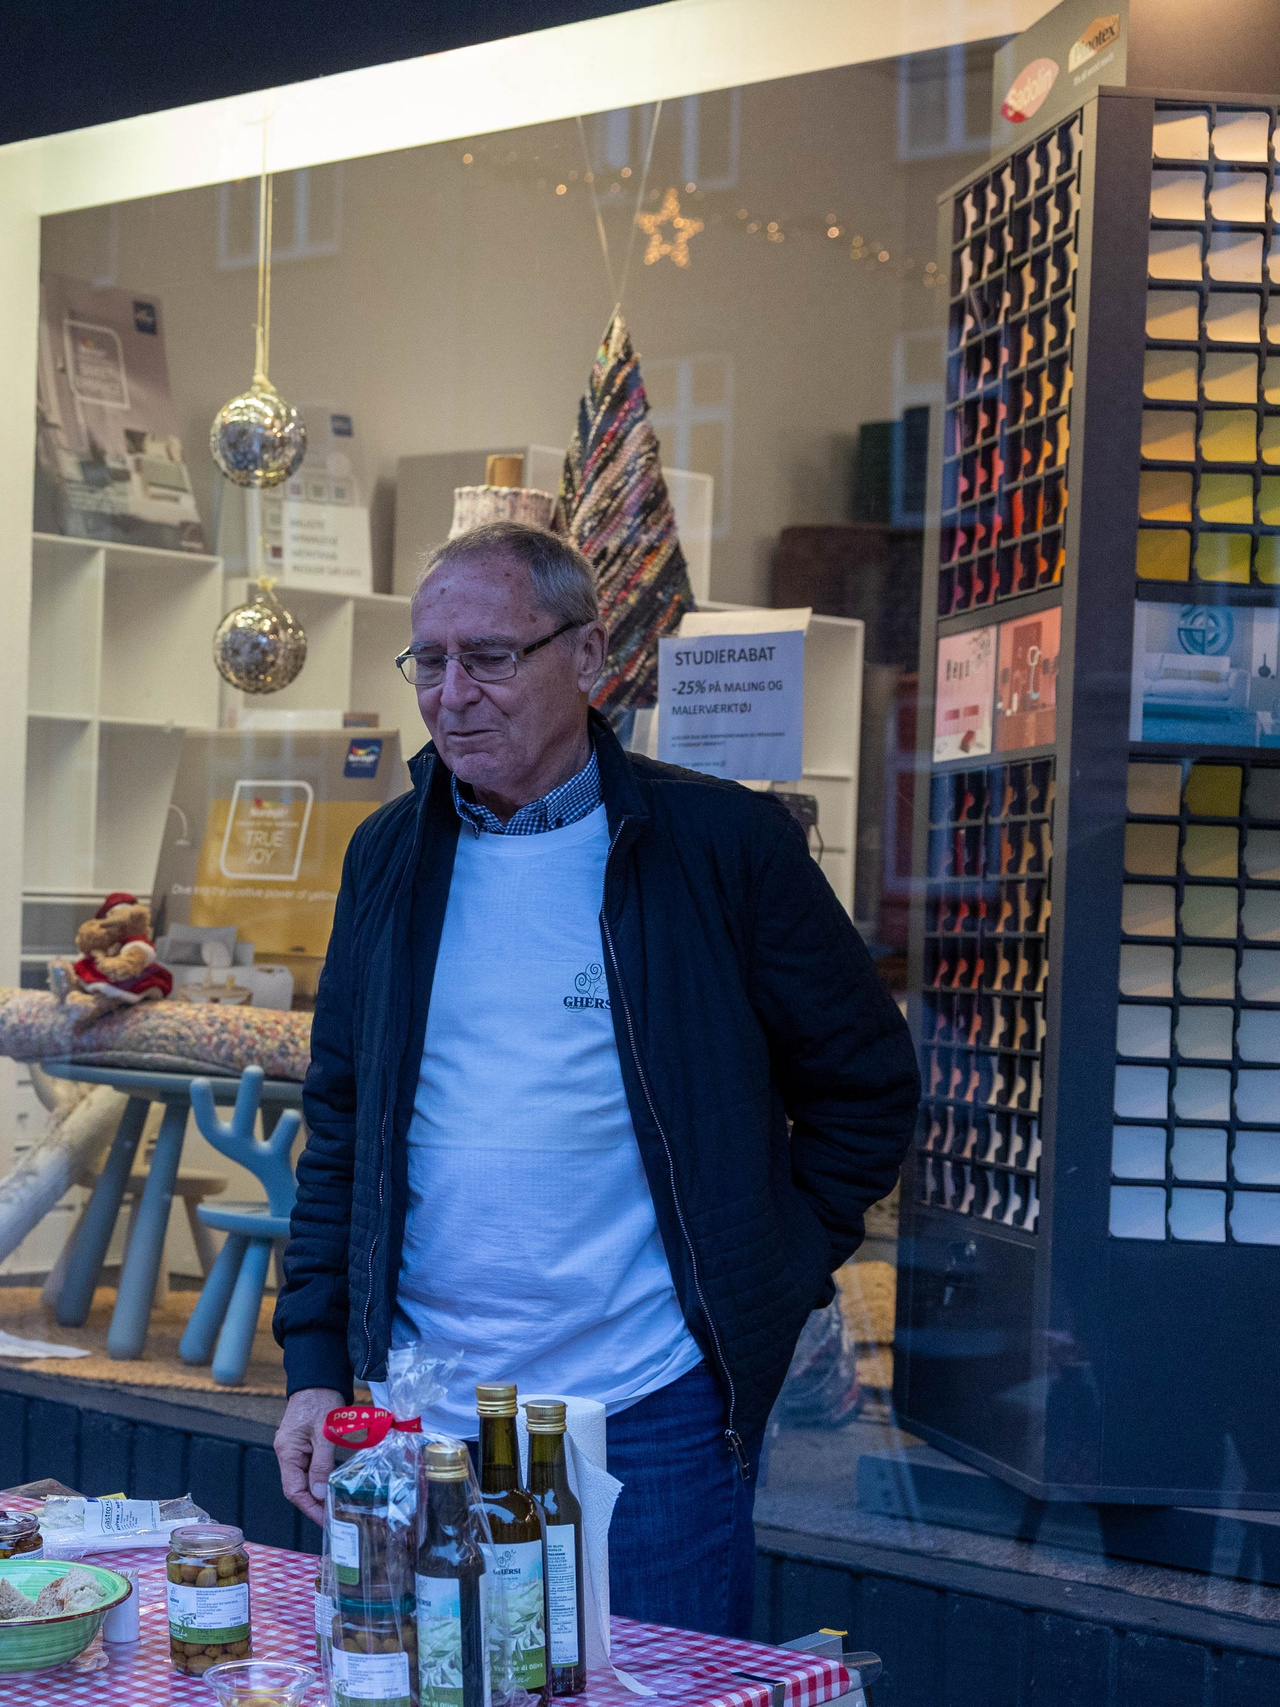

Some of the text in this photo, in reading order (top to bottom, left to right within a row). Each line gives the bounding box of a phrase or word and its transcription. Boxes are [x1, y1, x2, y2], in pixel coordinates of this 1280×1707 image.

[675, 646, 776, 666] STUDIERABAT
[672, 680, 783, 695] -25% PÅ MALING OG
[671, 702, 752, 716] MALERVÆRKTØJ
[245, 830, 285, 848] TRUE
[247, 848, 277, 864] JOY
[333, 1410, 357, 1421] God
[529, 1662, 543, 1671] Oliva
